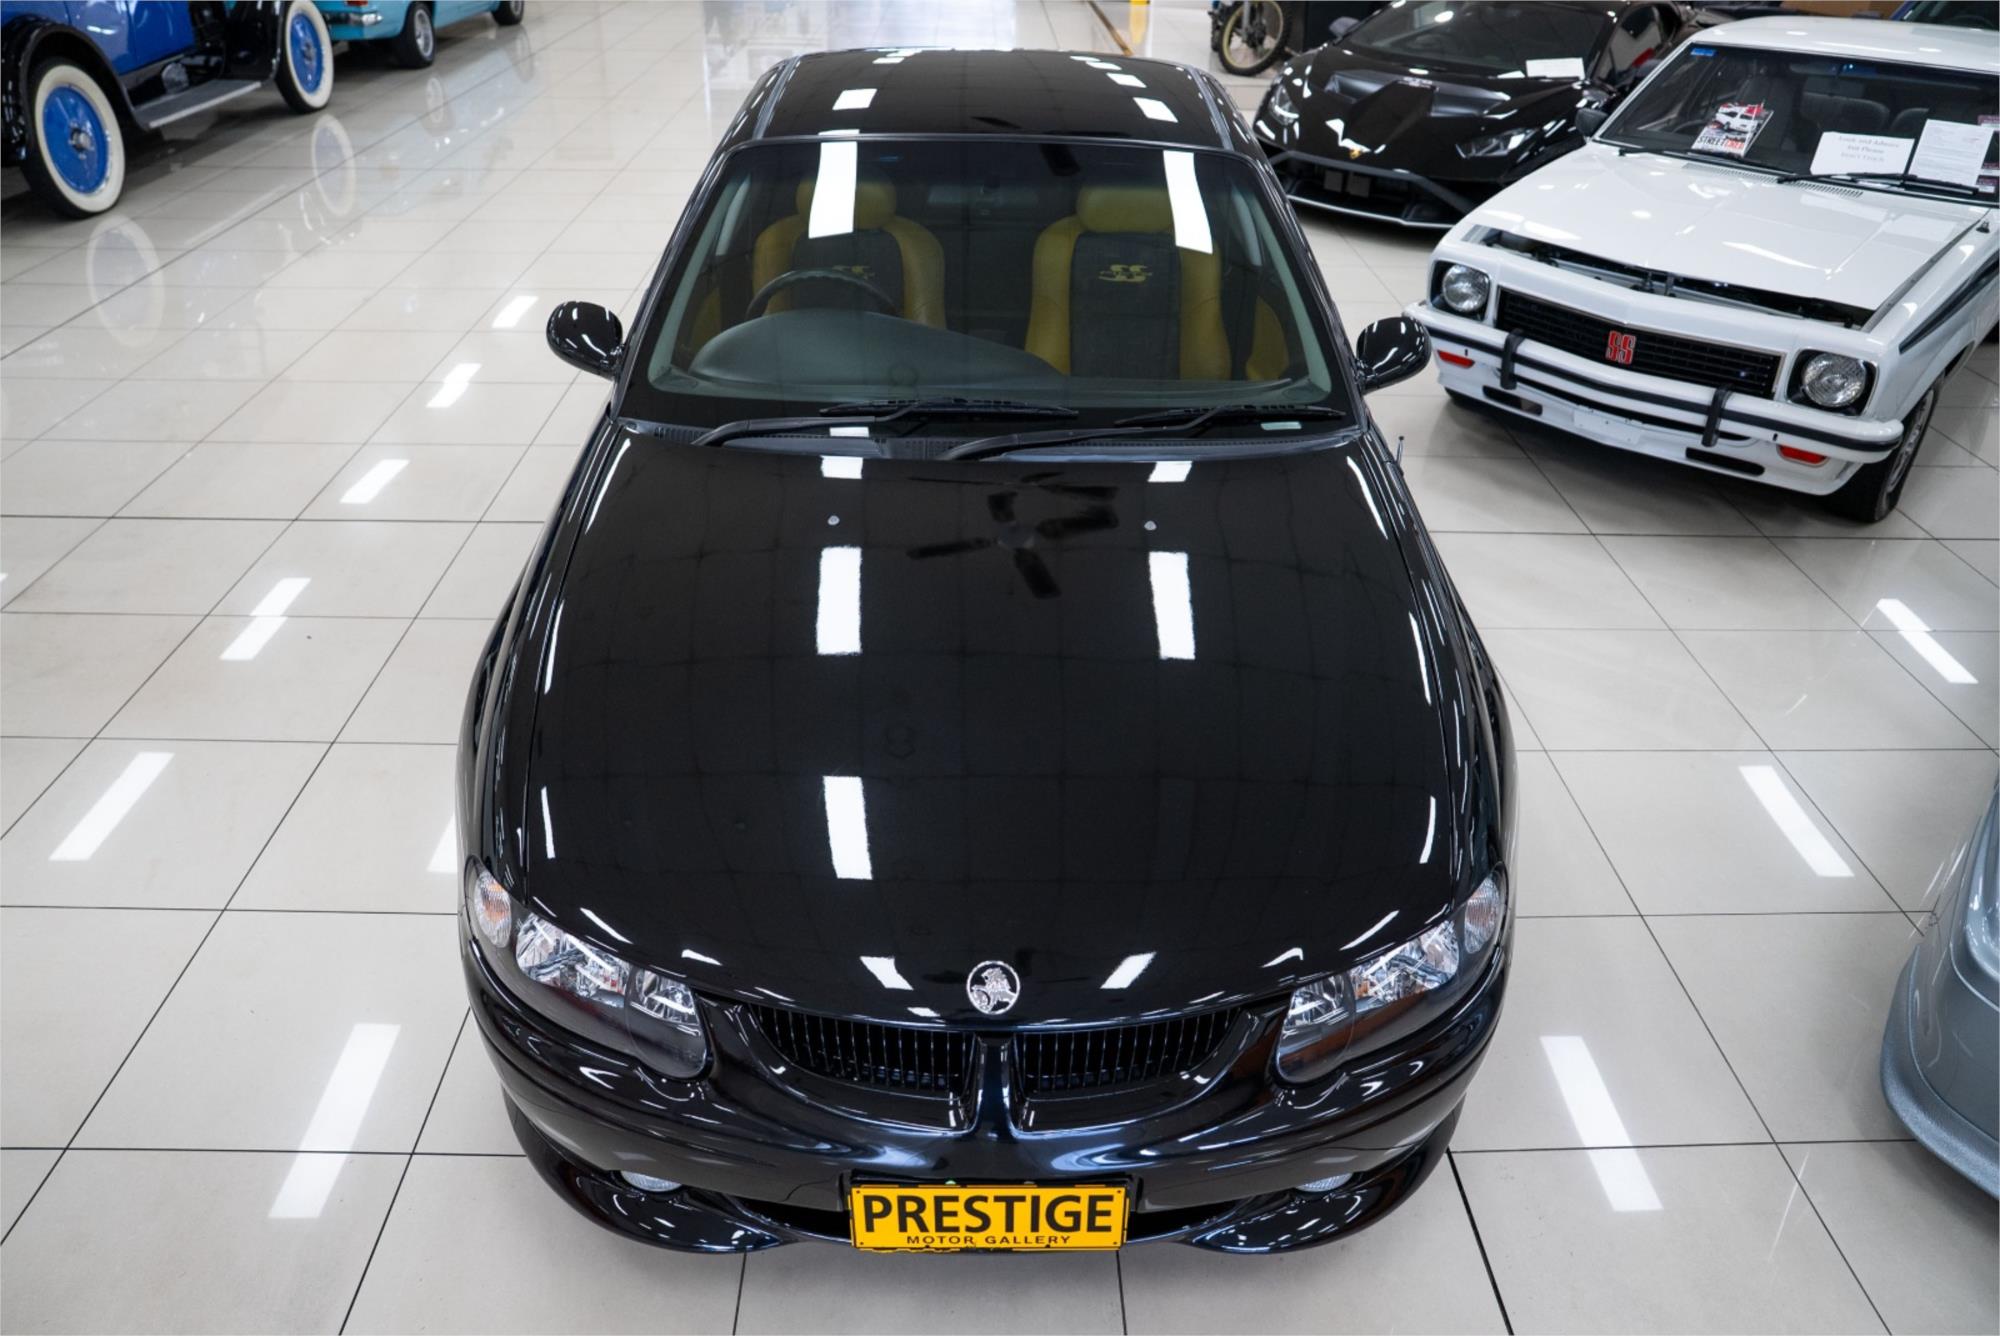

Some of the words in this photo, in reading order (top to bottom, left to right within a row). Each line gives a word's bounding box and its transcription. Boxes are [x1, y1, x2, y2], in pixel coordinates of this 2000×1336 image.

[1605, 330, 1637, 365] SS
[862, 1194, 1115, 1234] PRESTIGE
[906, 1235, 975, 1245] MOTOR
[984, 1235, 1071, 1245] GALLERY
